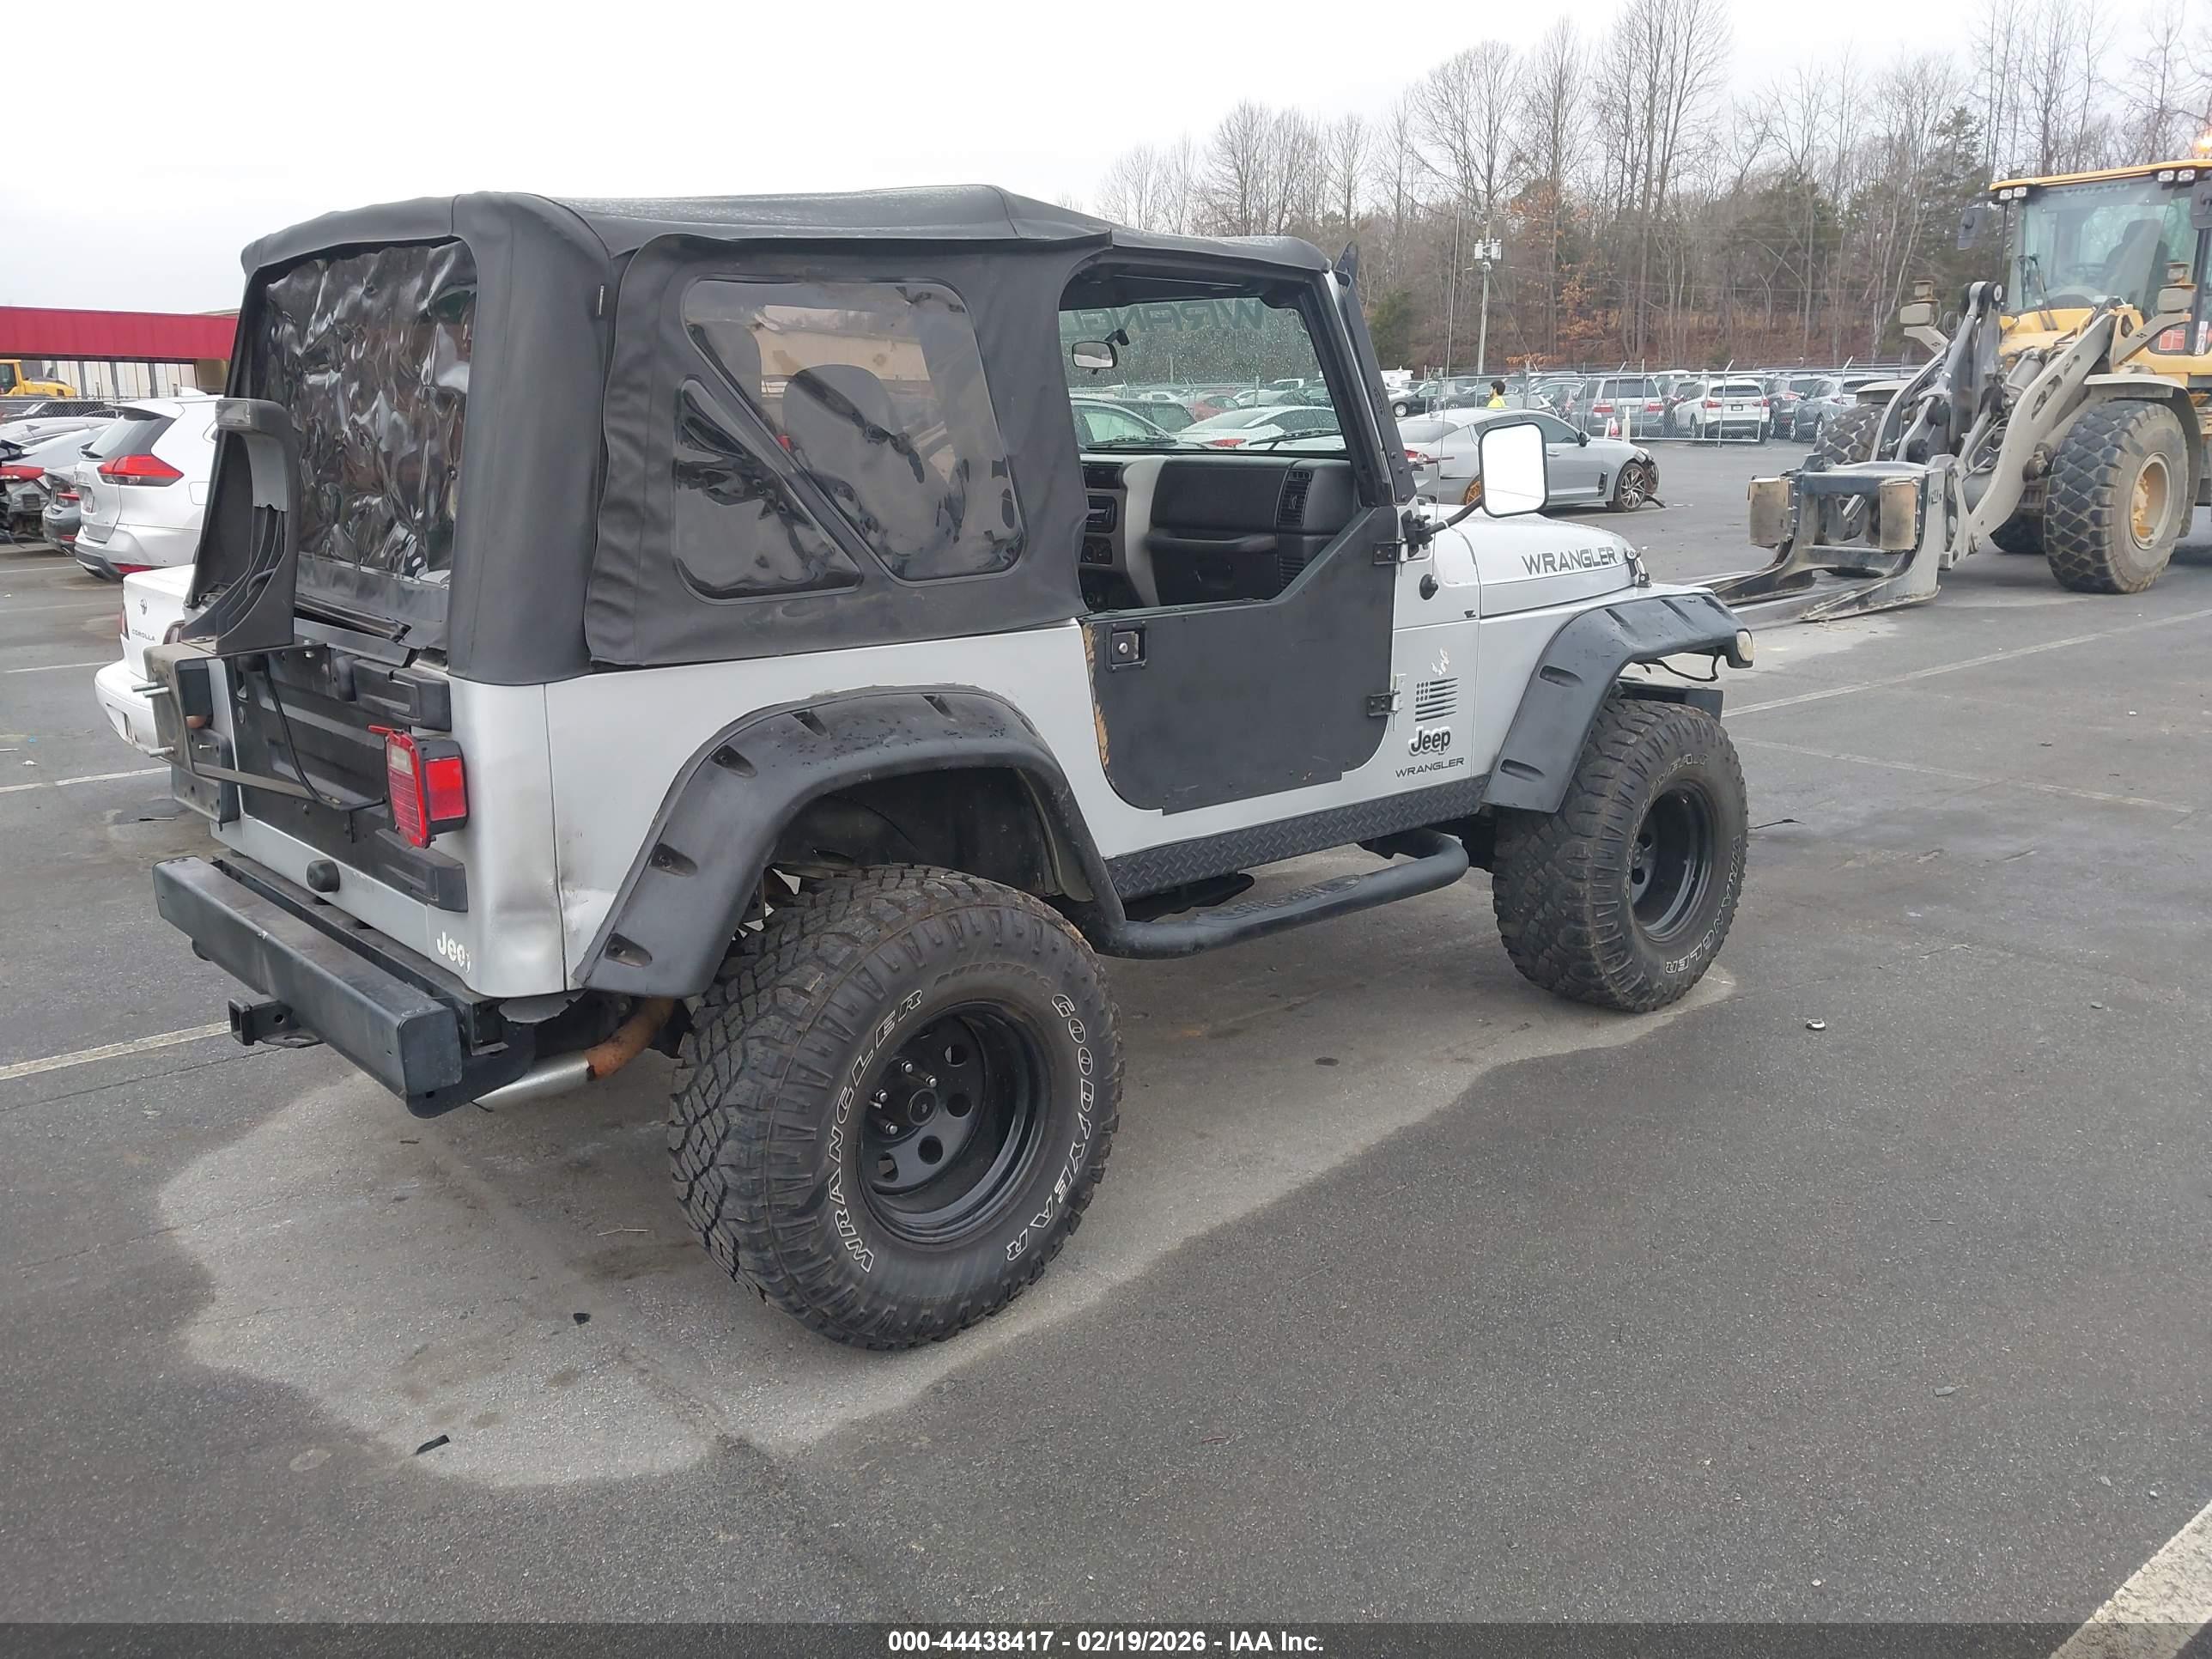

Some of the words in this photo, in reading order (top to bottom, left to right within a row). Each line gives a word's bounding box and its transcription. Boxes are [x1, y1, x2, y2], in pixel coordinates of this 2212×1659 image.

[1521, 546, 1619, 575] WRANGLER
[131, 629, 155, 641] COROLLA
[1409, 726, 1451, 756] Jeep
[1395, 757, 1465, 778] WRANGLER
[1665, 835, 1741, 975] WRANGLER
[828, 989, 923, 1273] WRANGLER
[1006, 994, 1095, 1261] GOODYEAR
